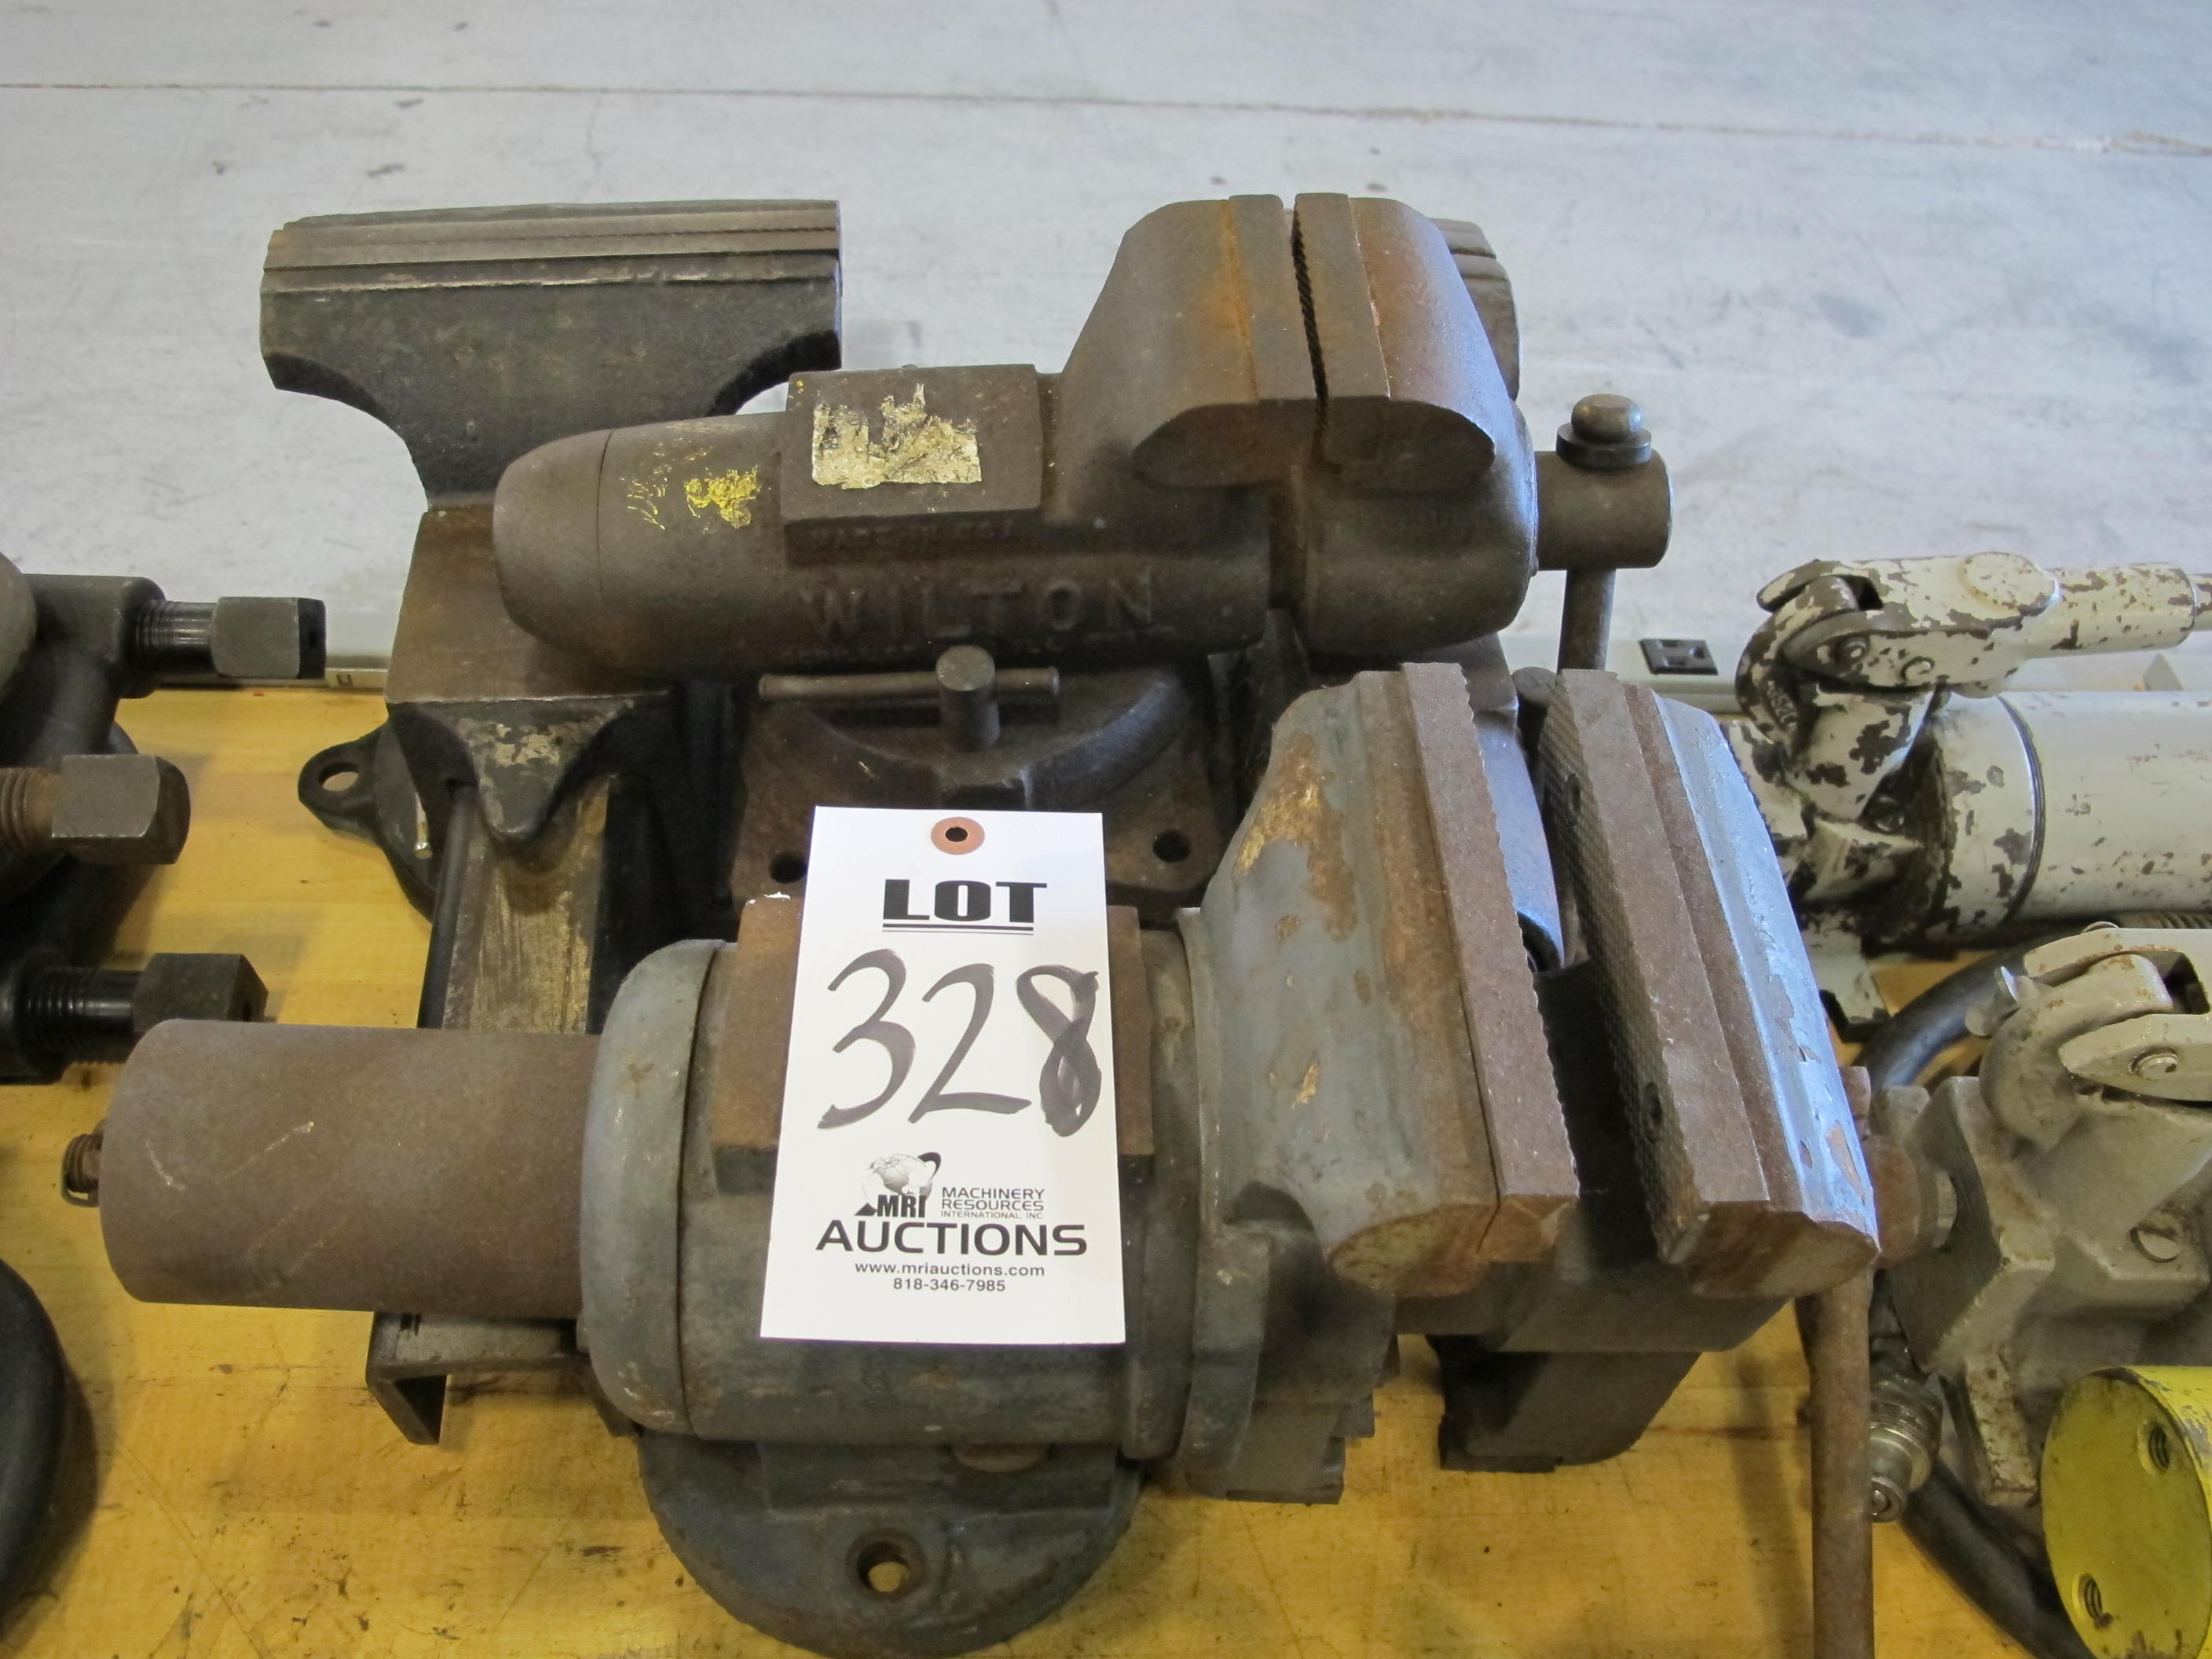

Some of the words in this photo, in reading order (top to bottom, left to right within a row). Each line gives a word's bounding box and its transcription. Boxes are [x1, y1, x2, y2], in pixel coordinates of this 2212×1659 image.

[798, 566, 1155, 639] WILTON
[883, 879, 1047, 923] LOT
[817, 949, 1101, 1137] 328
[943, 1187, 1045, 1199] MACHINERY
[943, 1199, 1045, 1211] RESOURCES
[877, 1194, 927, 1218] MRI
[815, 1219, 1087, 1256] AUCTIONS
[855, 1262, 1046, 1276] www.mriauctions.com
[892, 1277, 1006, 1292] 818-346-7985
